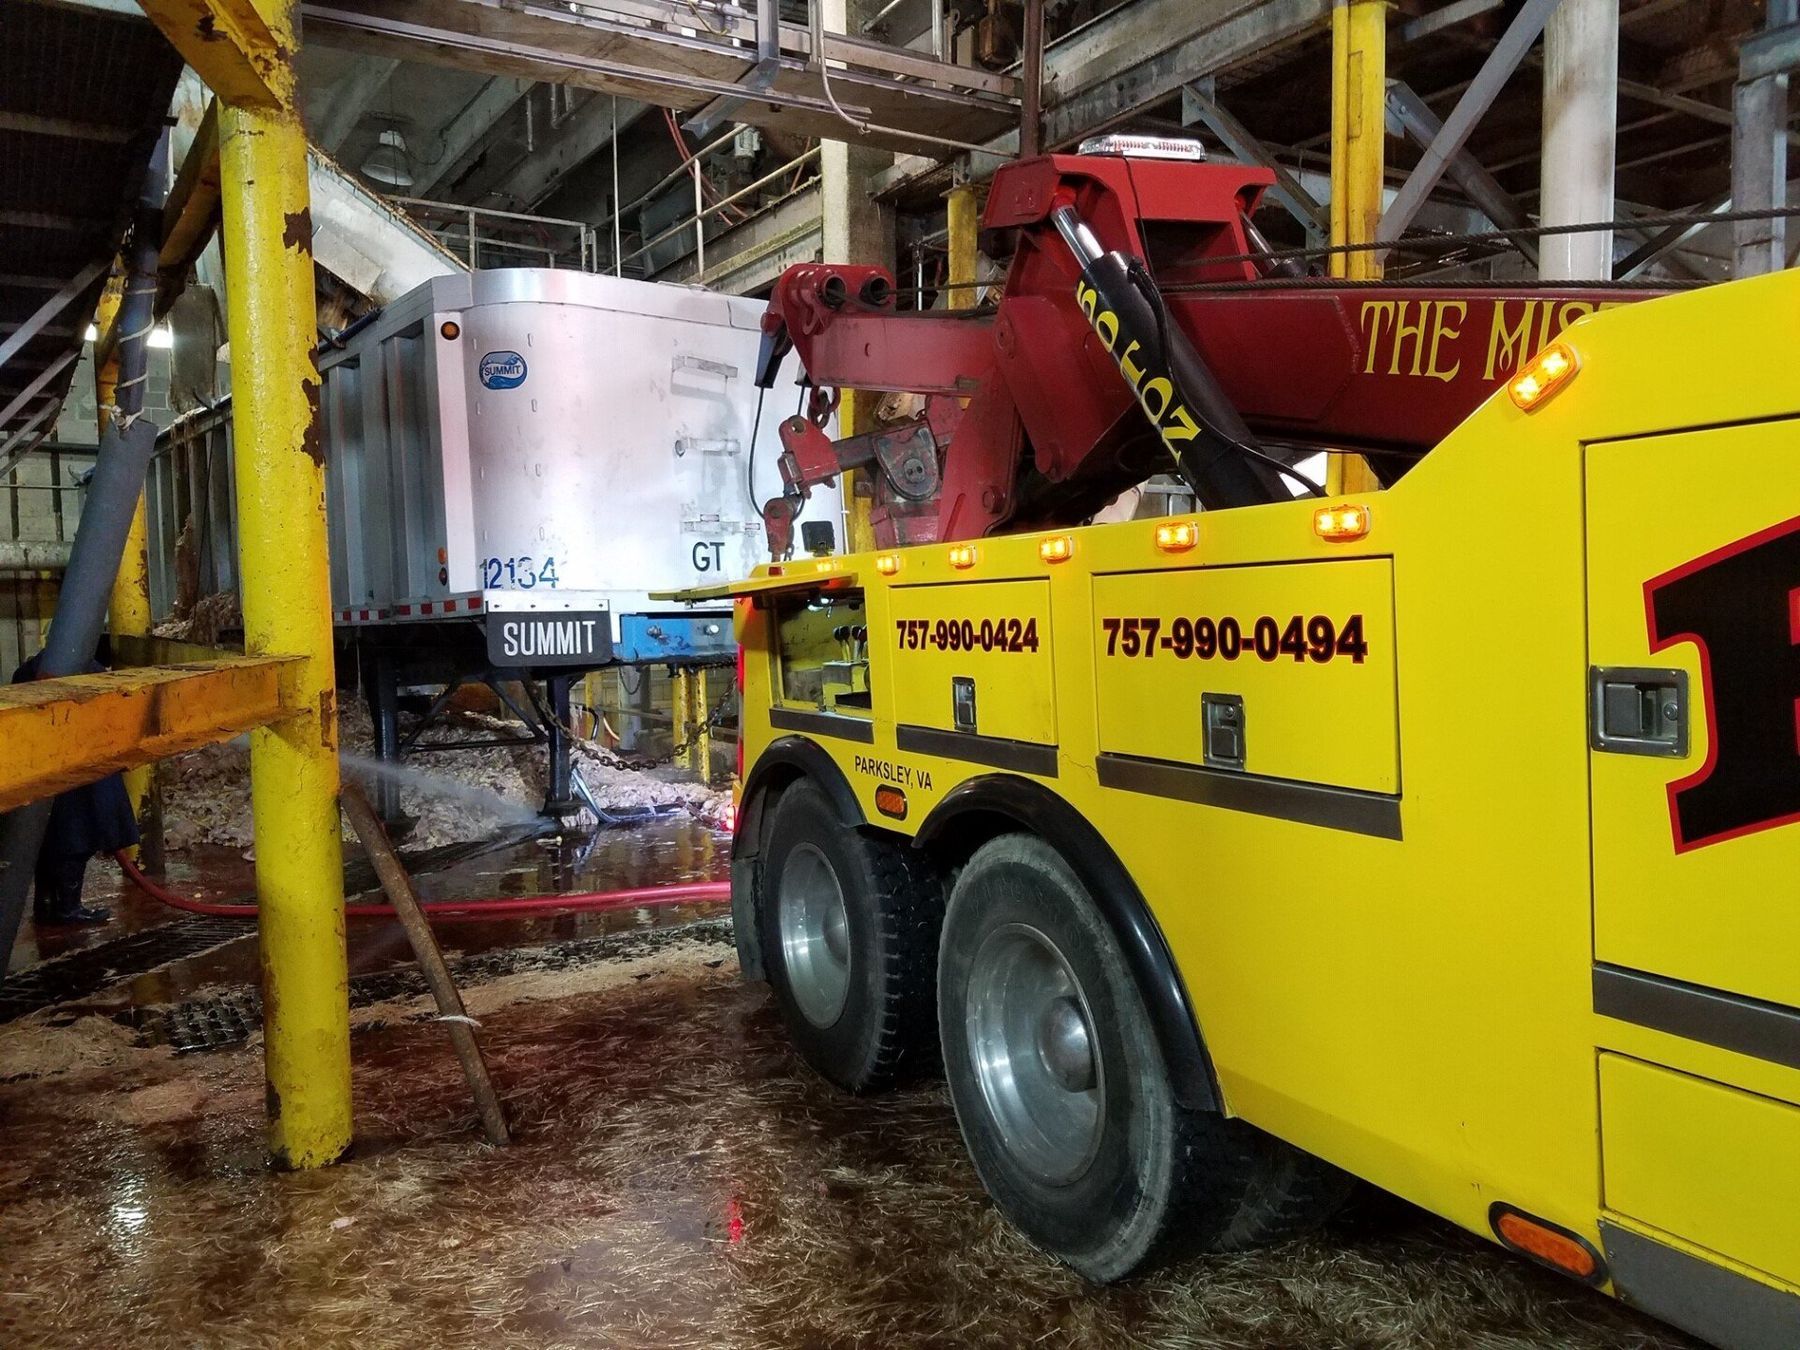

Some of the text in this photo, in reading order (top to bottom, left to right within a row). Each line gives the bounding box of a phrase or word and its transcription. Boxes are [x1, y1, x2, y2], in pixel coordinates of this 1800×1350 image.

[1360, 301, 1467, 383] THE
[484, 365, 521, 377] SUMMIT
[479, 556, 559, 590] 12134
[692, 541, 725, 572] GT
[503, 620, 596, 656] SUMMIT
[895, 616, 1040, 653] 757-990-0424
[1102, 614, 1369, 665] 757-990-0494
[854, 754, 933, 792] PARKSLEY, VA
